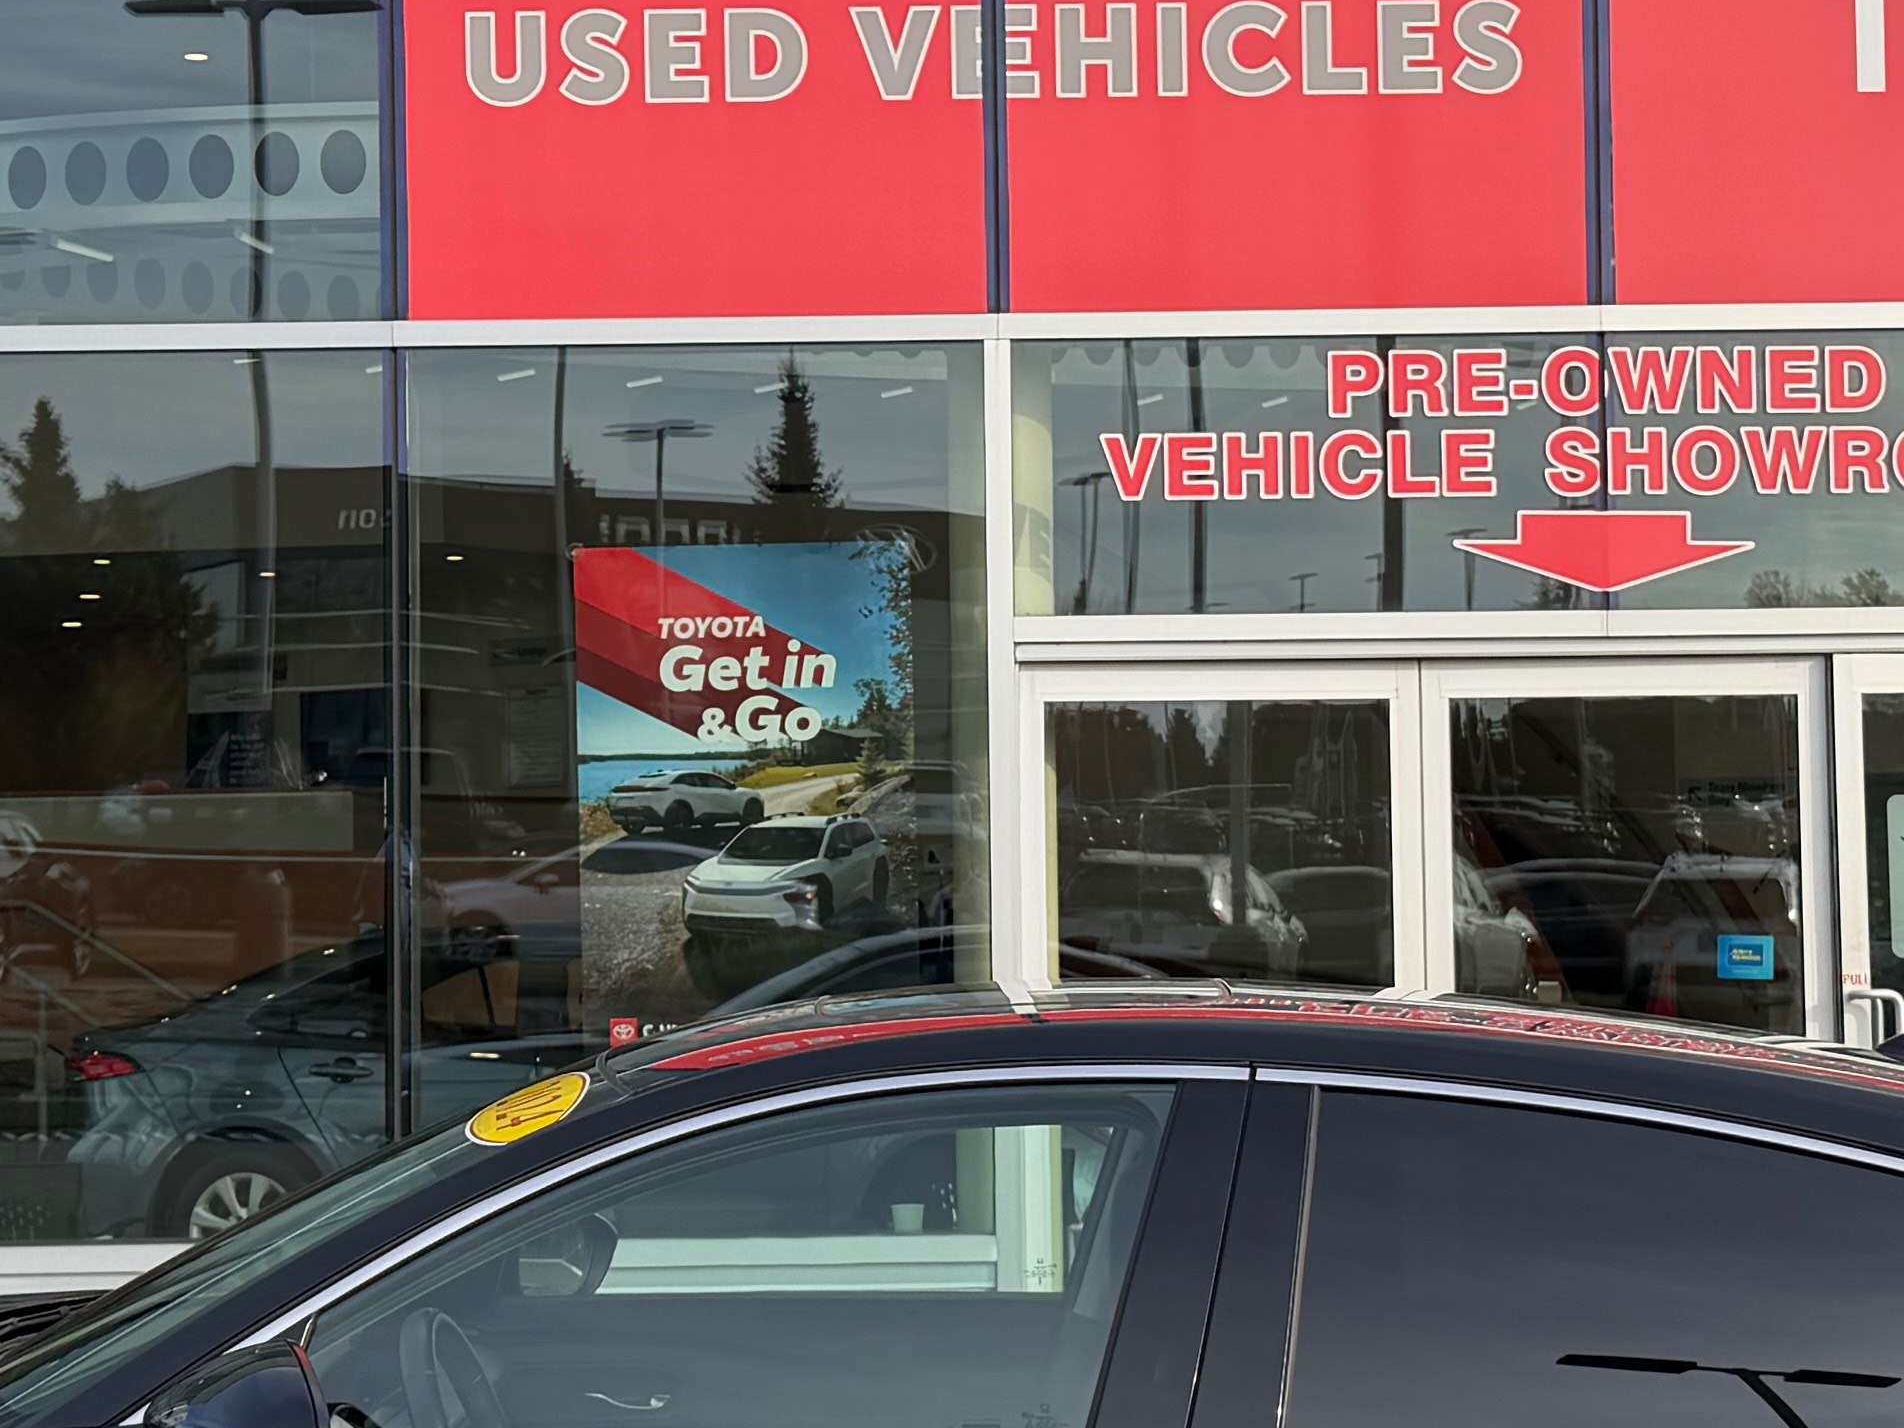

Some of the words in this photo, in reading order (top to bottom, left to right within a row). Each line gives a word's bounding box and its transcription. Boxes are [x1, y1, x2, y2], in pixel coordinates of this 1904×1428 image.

[463, 7, 808, 108] USED
[1327, 343, 1887, 421] PRE-OWNED
[1099, 428, 1499, 503] VEHICLE
[657, 614, 767, 641] TOYOTA
[658, 645, 773, 693] Get
[781, 638, 838, 690] in
